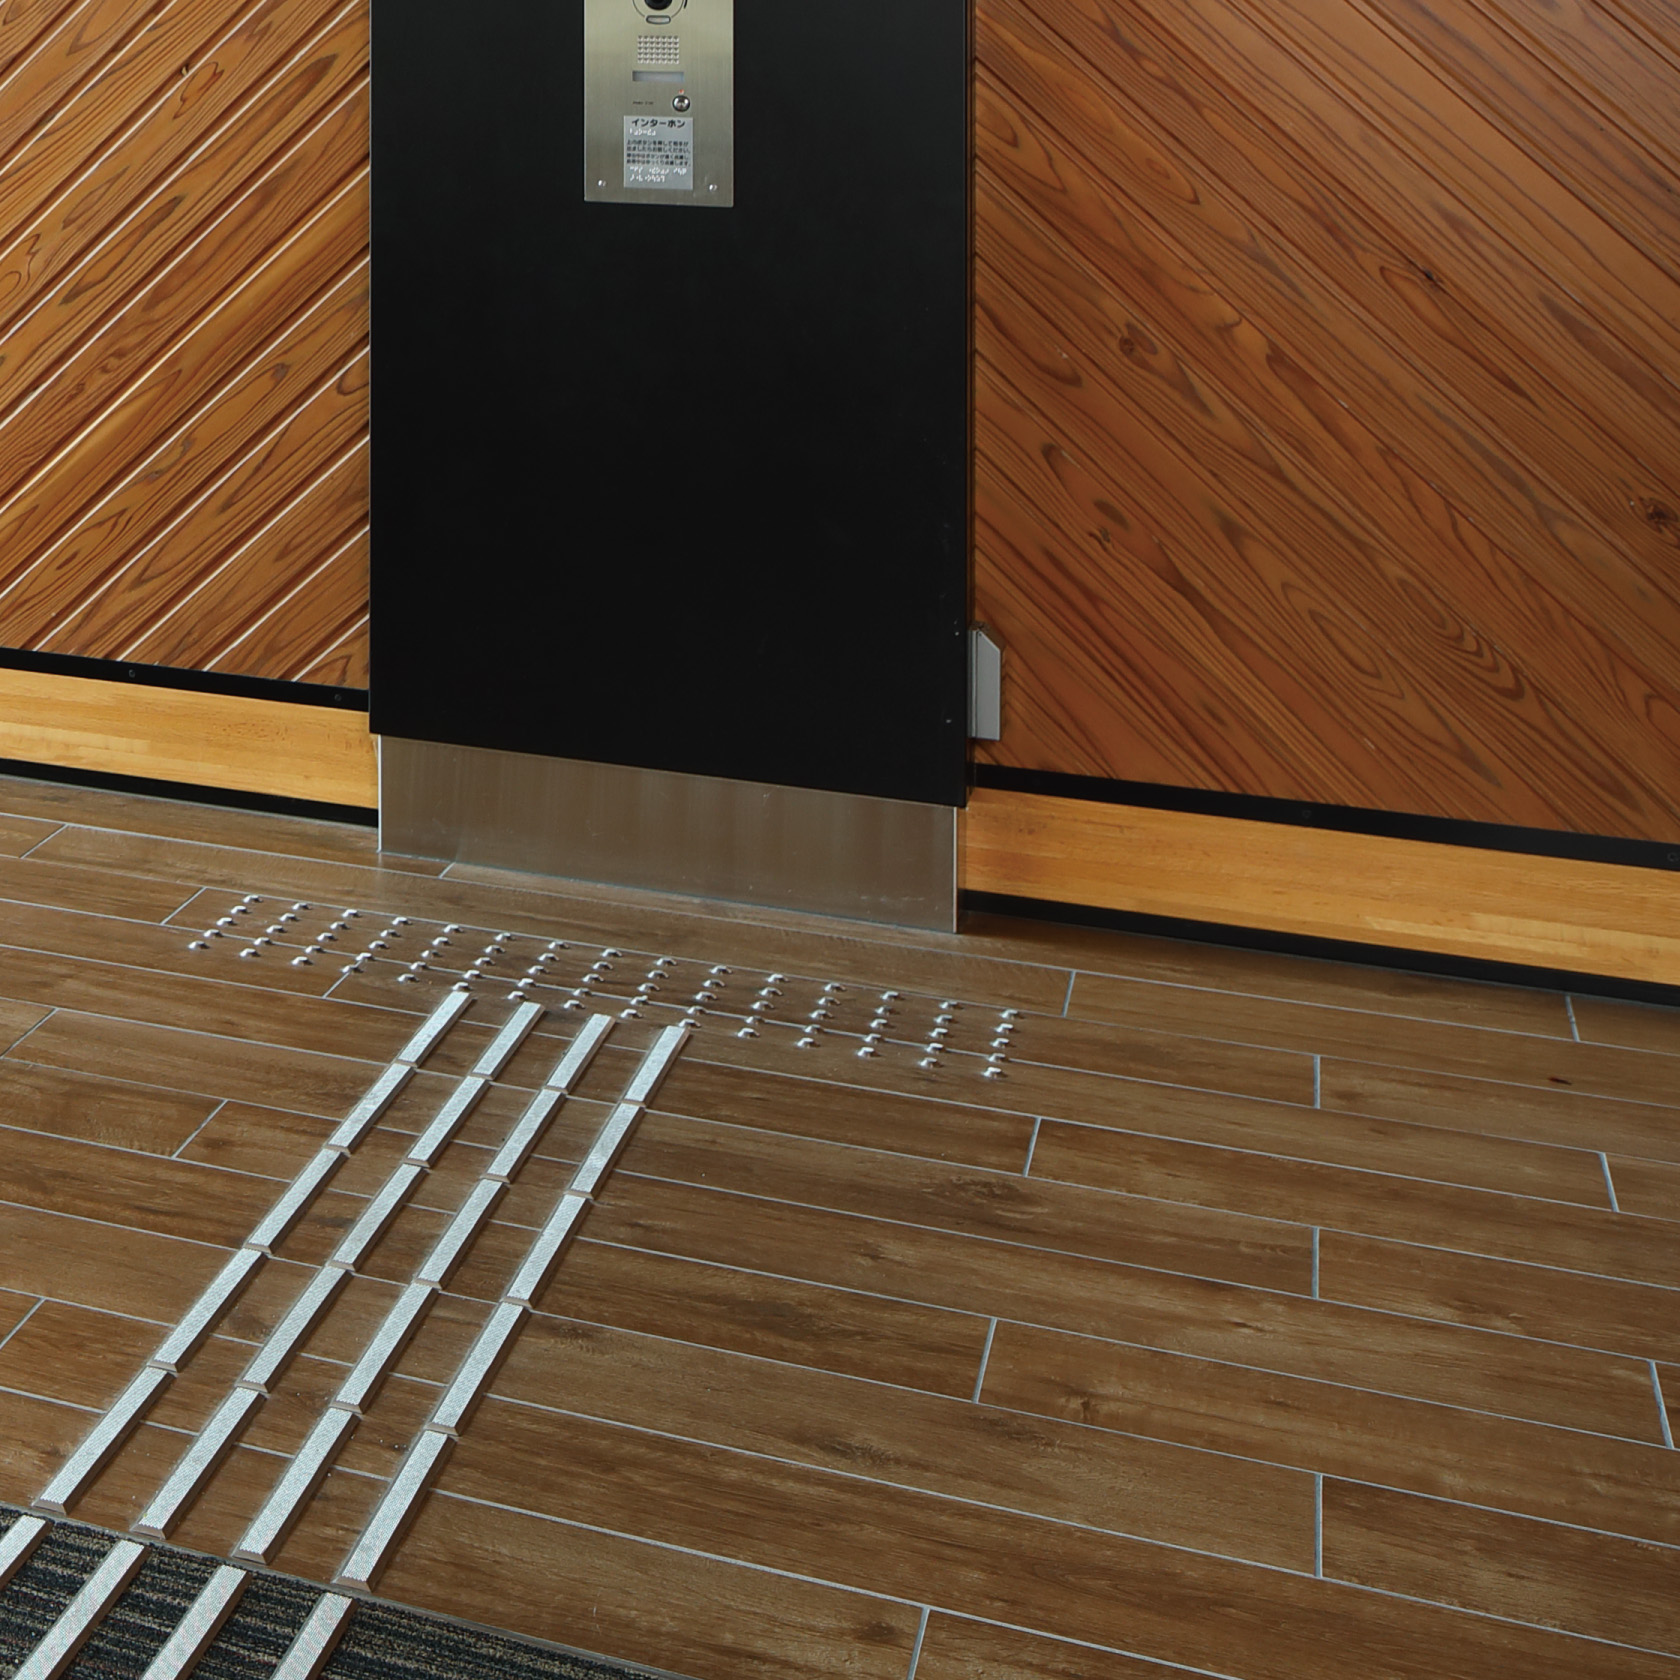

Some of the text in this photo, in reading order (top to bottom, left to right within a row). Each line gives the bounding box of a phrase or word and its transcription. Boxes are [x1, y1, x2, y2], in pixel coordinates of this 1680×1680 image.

[631, 118, 686, 128] インターホン
